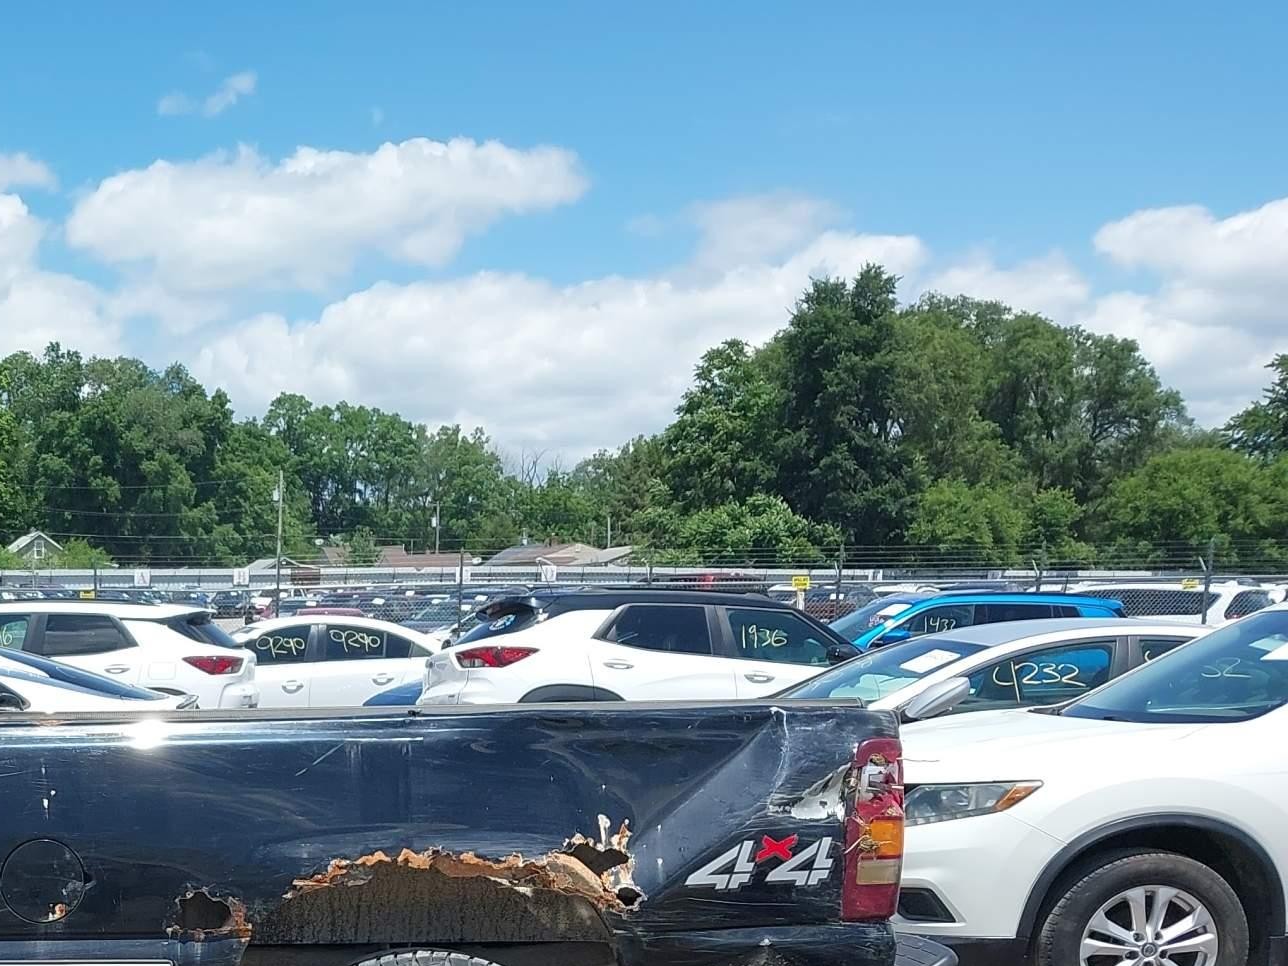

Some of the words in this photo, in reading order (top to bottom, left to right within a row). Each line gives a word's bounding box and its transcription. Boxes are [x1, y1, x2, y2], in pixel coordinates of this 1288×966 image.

[255, 635, 306, 659] 9290
[328, 629, 381, 653] 9290
[741, 623, 788, 649] 1936
[992, 660, 1087, 704] 4232
